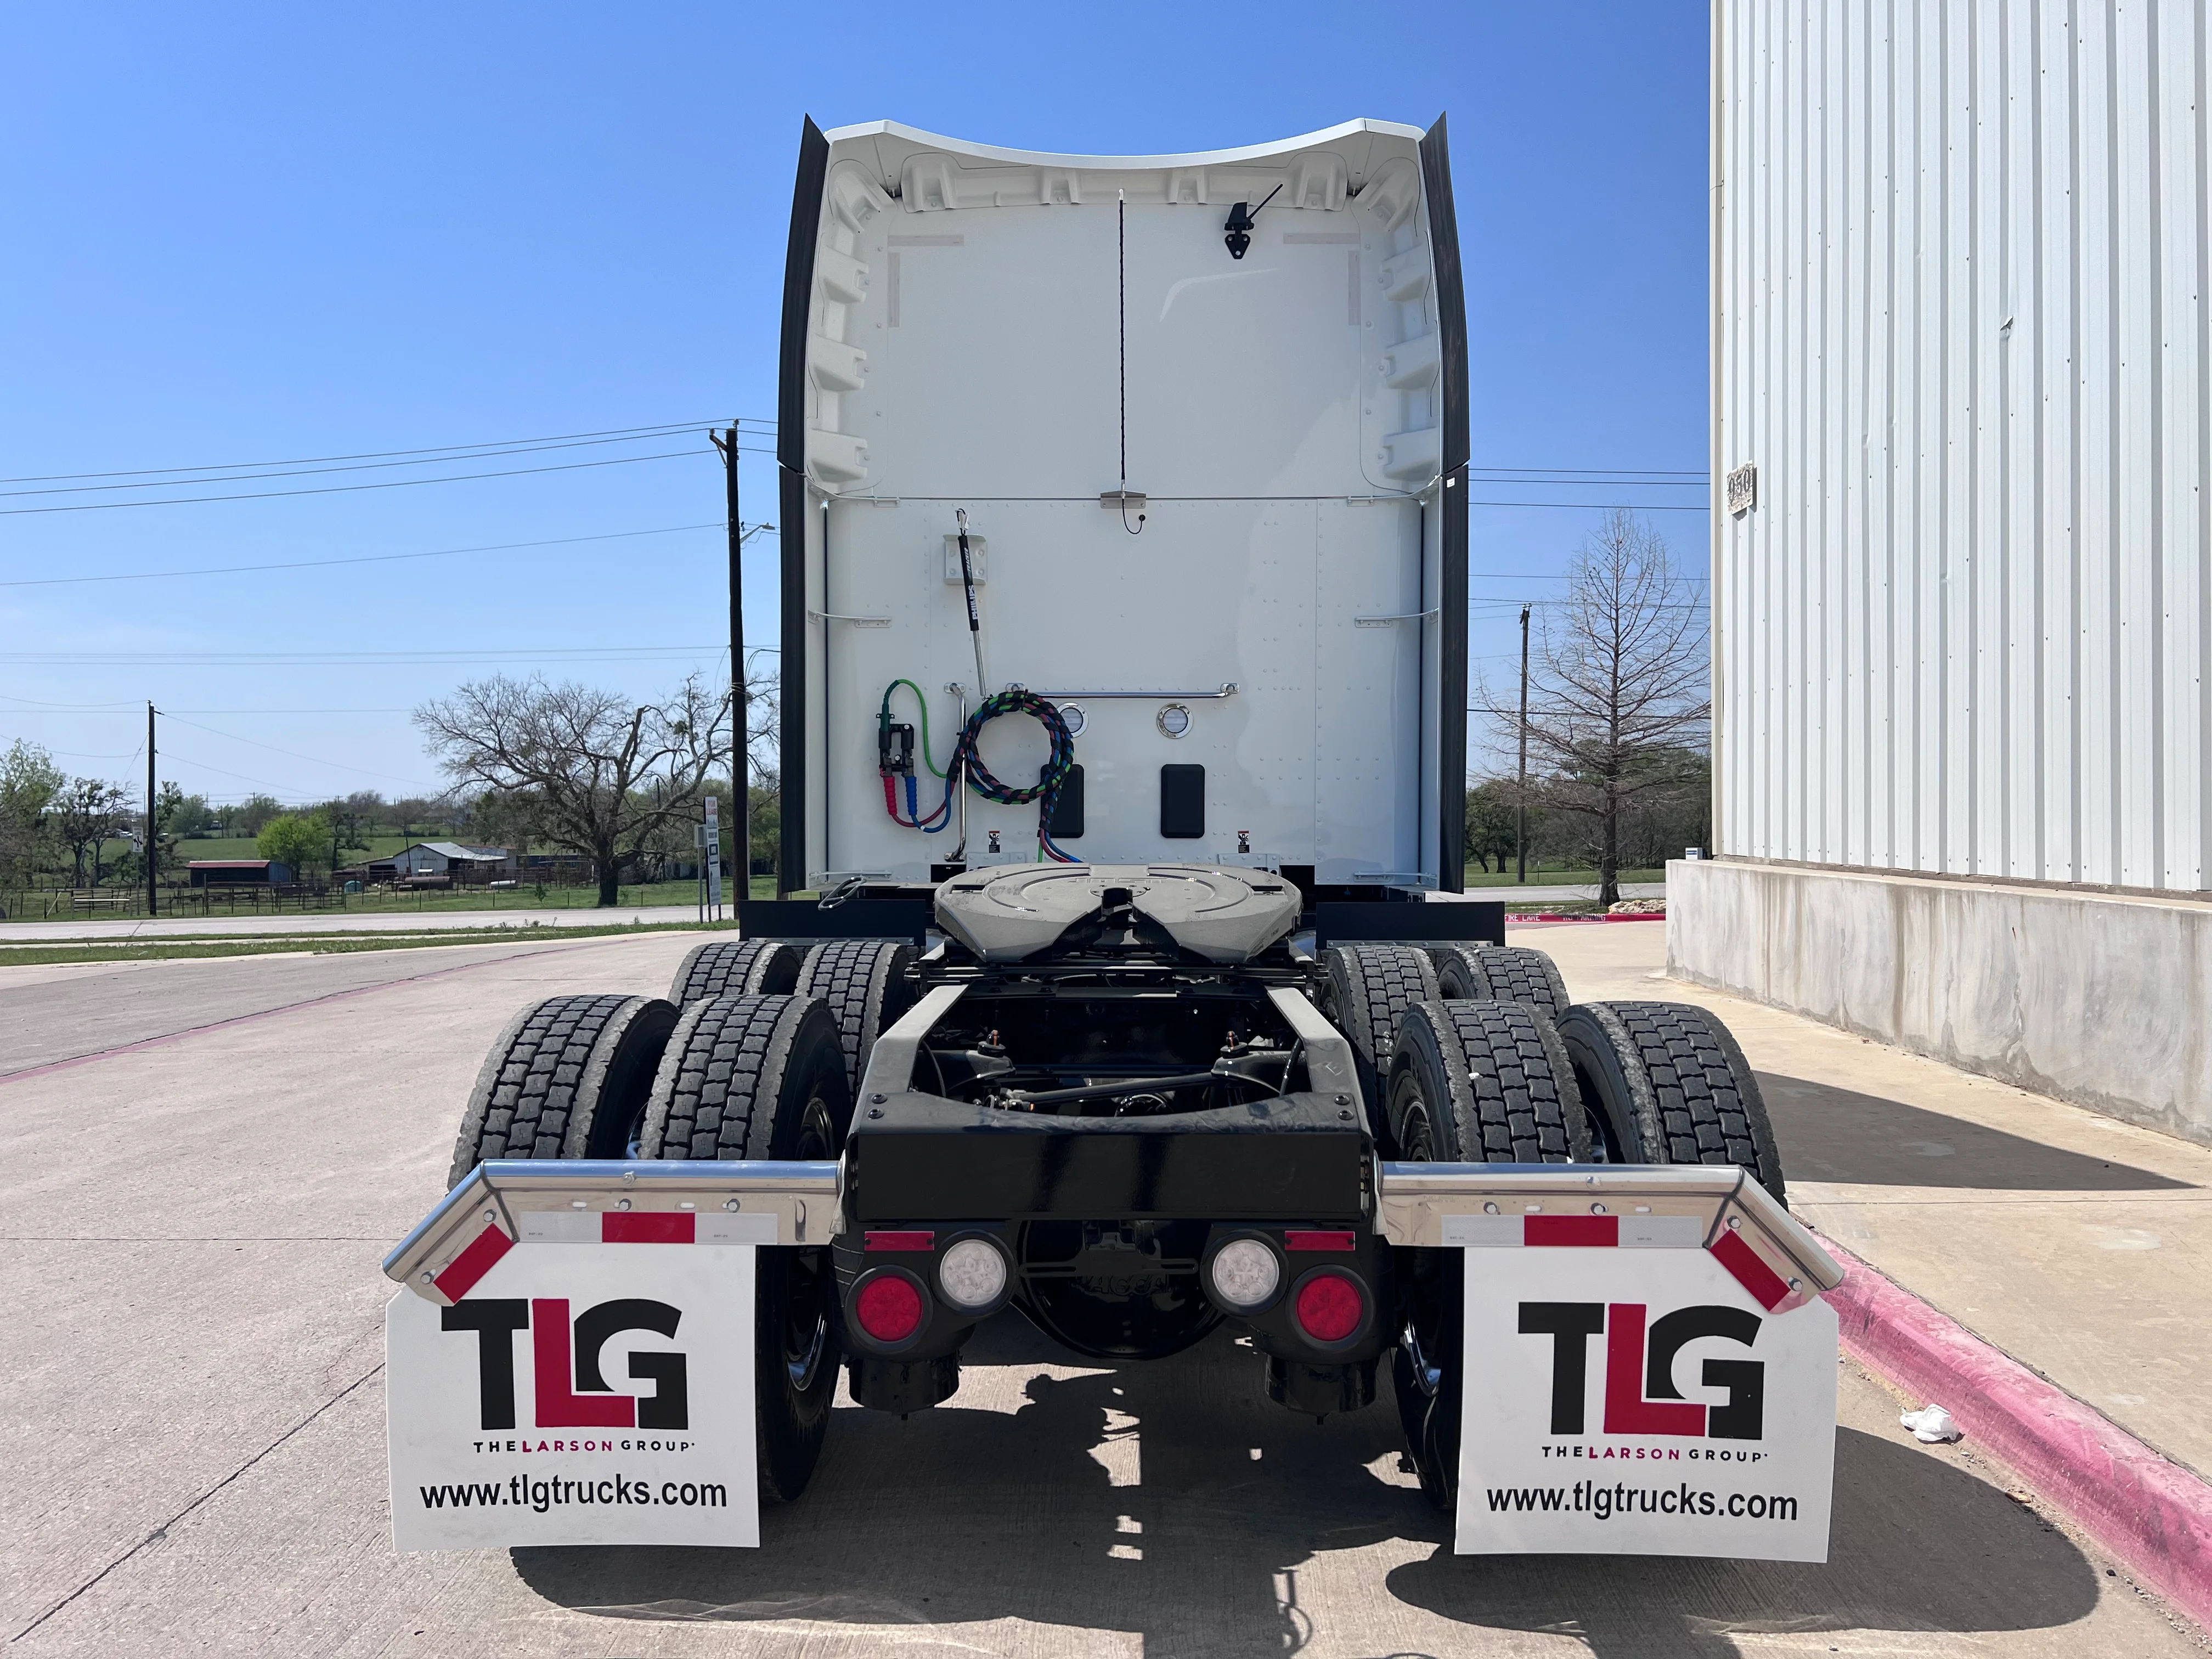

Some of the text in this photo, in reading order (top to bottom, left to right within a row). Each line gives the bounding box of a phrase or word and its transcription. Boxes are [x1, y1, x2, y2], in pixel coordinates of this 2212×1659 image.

[441, 1298, 689, 1430] TLG
[1518, 1302, 1765, 1441] TLG
[620, 1440, 689, 1452] GROUP
[1689, 1448, 1761, 1463] GROUP
[420, 1473, 727, 1513] www.tlgtrucks.com
[1487, 1480, 1797, 1521] www.tlgtrucks.com
